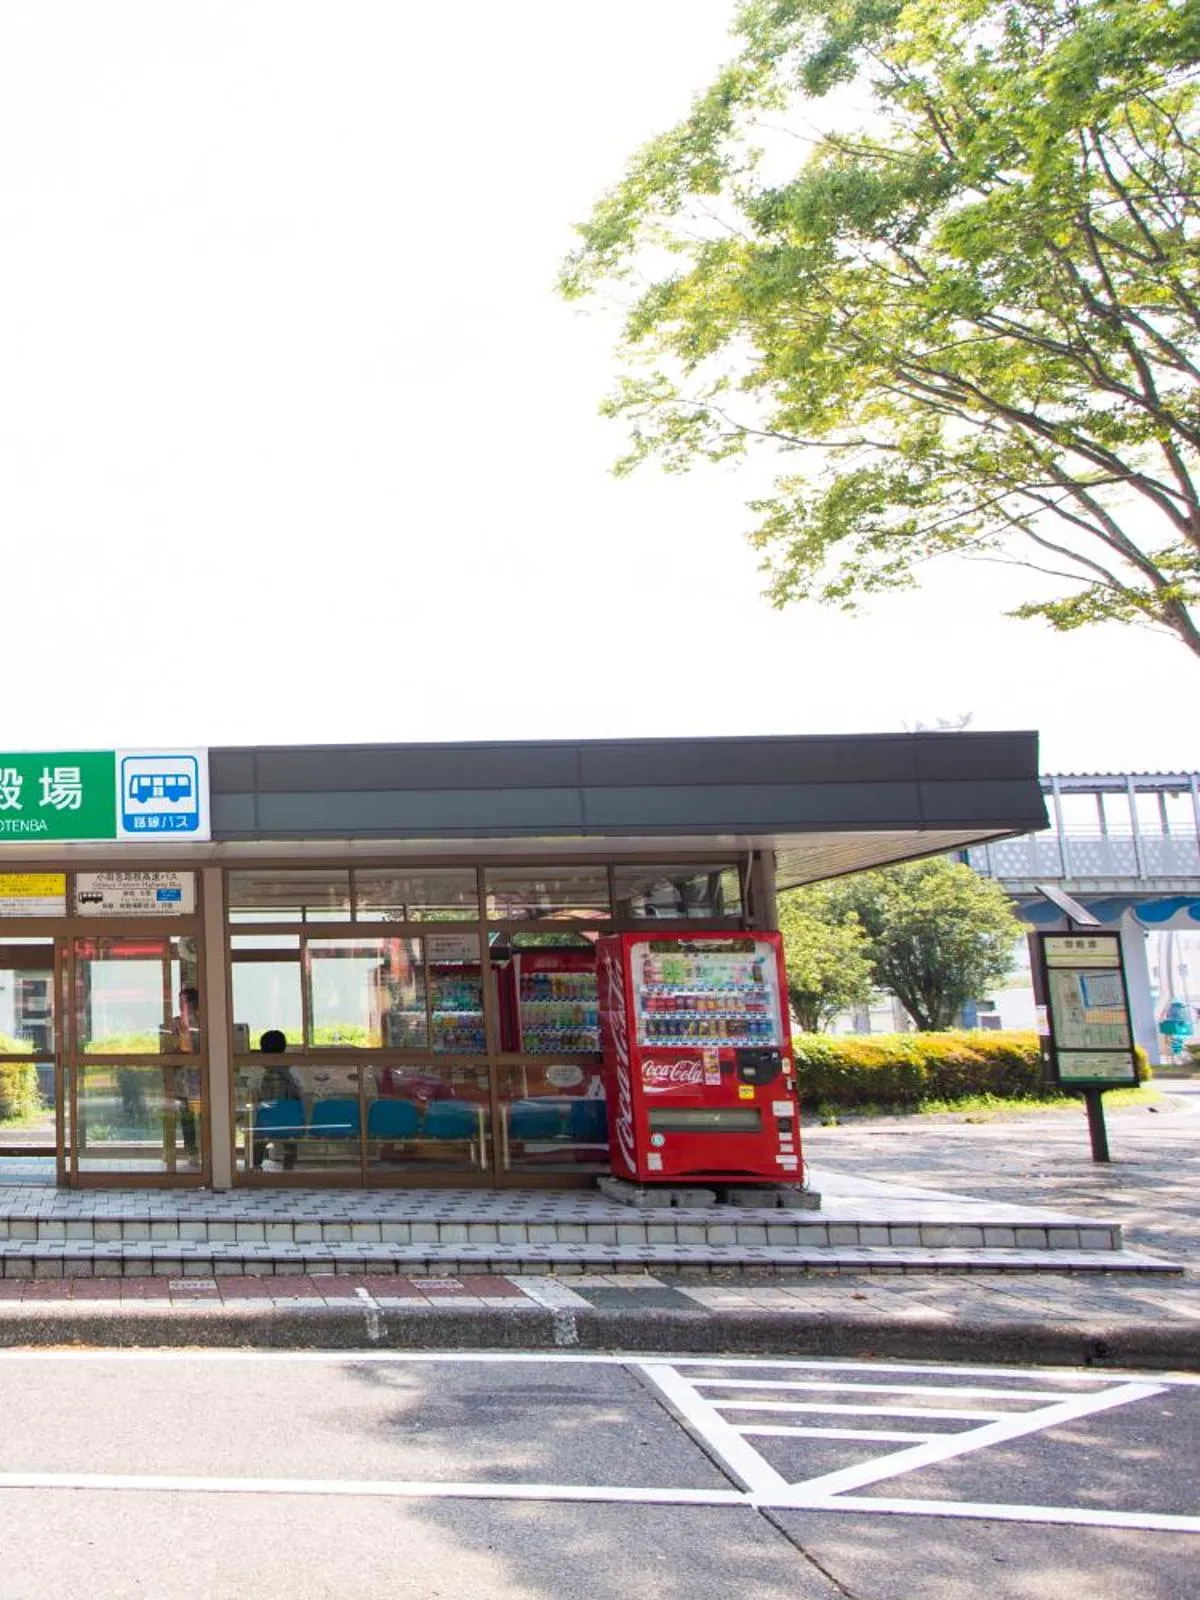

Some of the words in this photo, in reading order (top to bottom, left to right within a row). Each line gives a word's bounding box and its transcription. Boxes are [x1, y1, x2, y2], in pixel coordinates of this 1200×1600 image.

[132, 815, 188, 829] 路線バス
[641, 1059, 704, 1082] Coca-Cola
